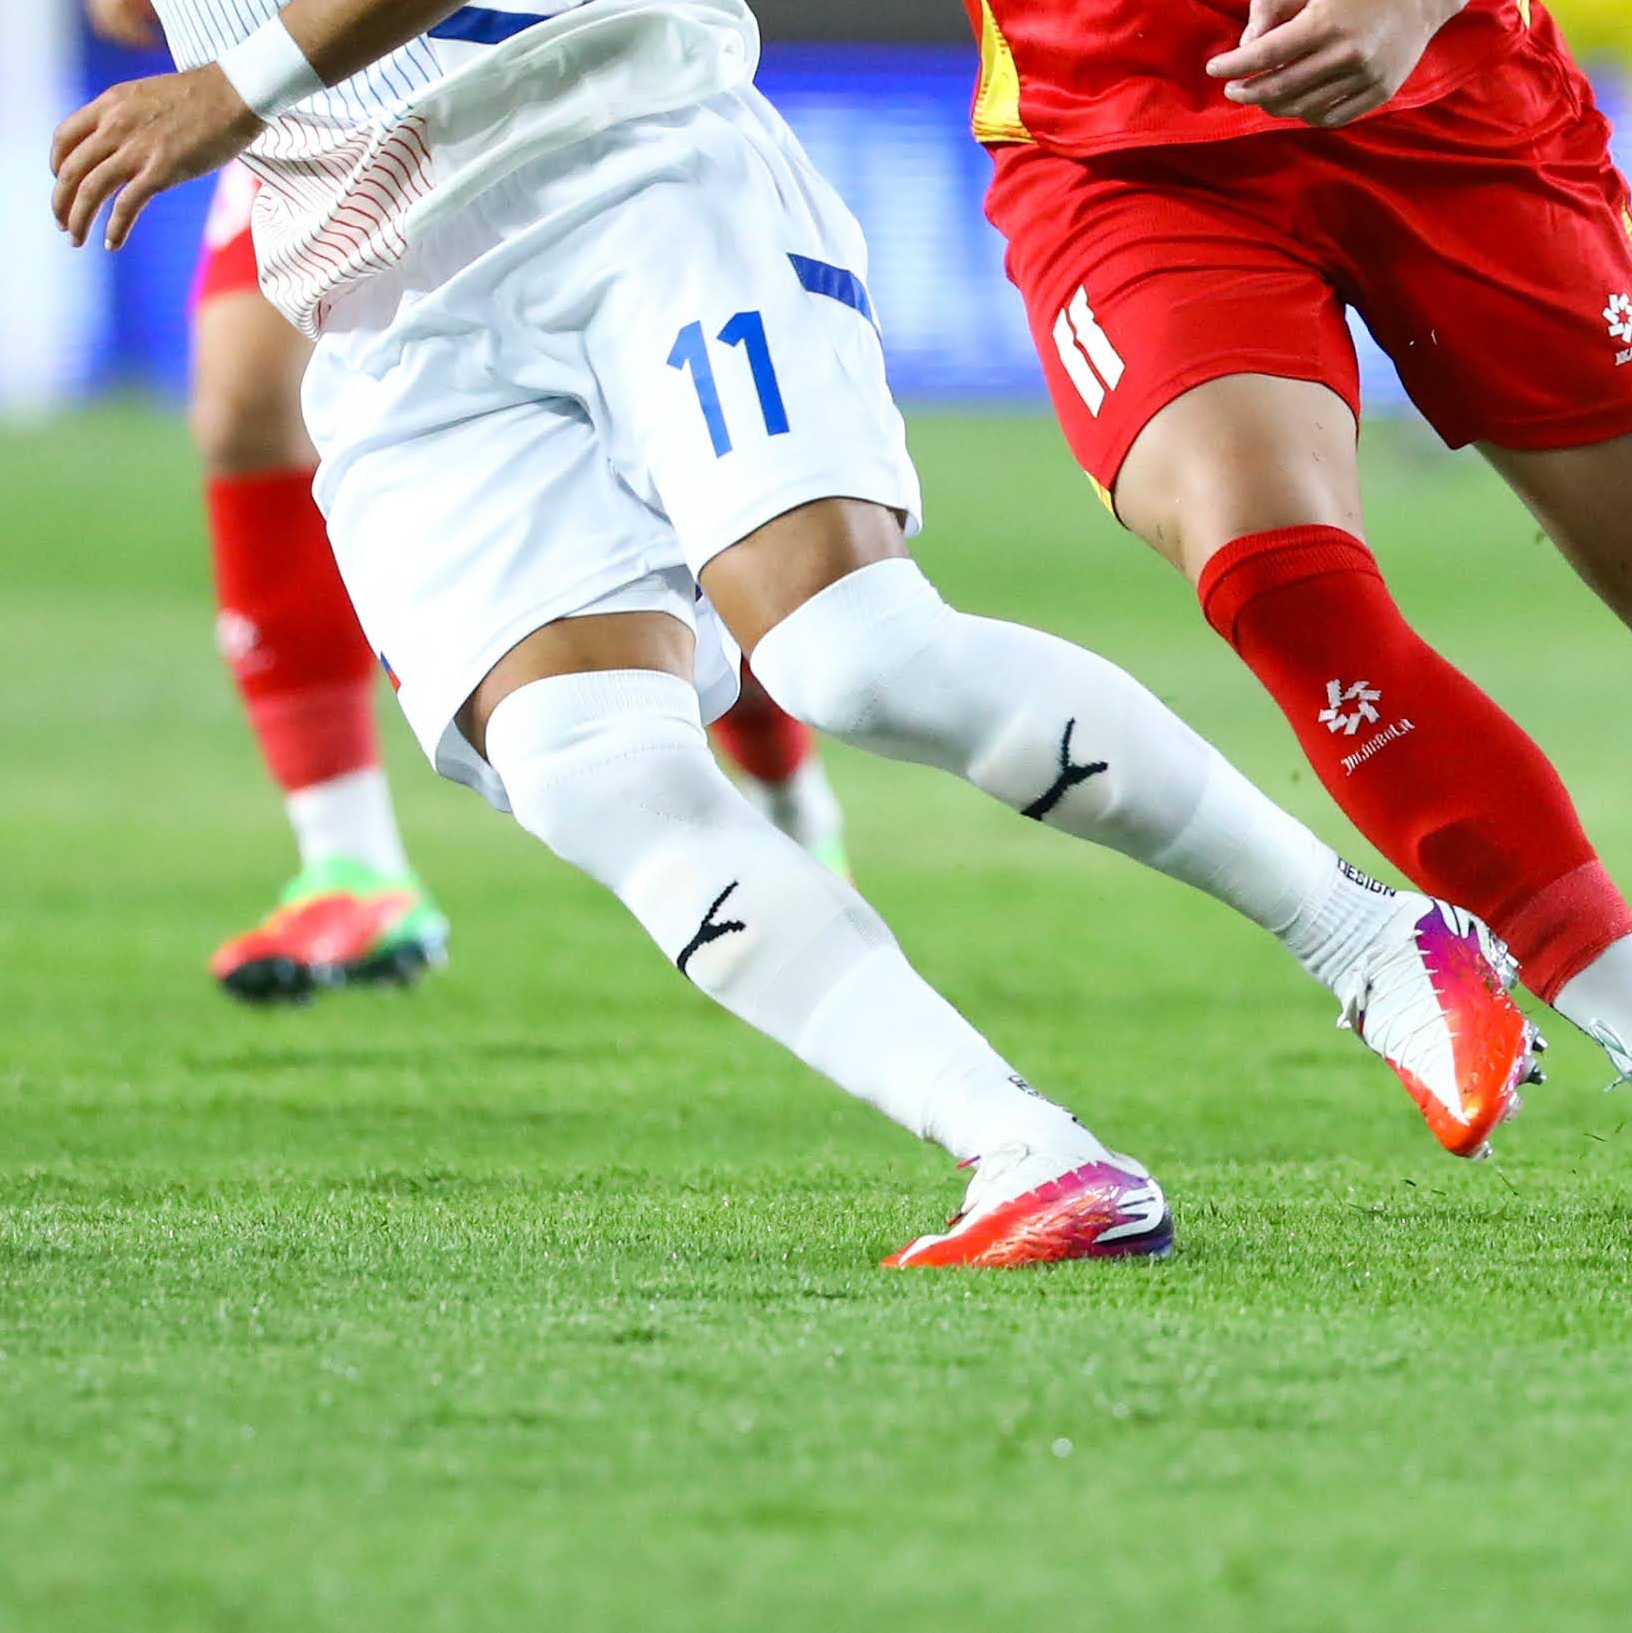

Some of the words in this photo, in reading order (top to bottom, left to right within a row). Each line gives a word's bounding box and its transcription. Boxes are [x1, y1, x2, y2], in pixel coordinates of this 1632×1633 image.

[666, 310, 791, 459] 11
[1052, 283, 1126, 419] 11
[1337, 857, 1397, 898] DESIGN
